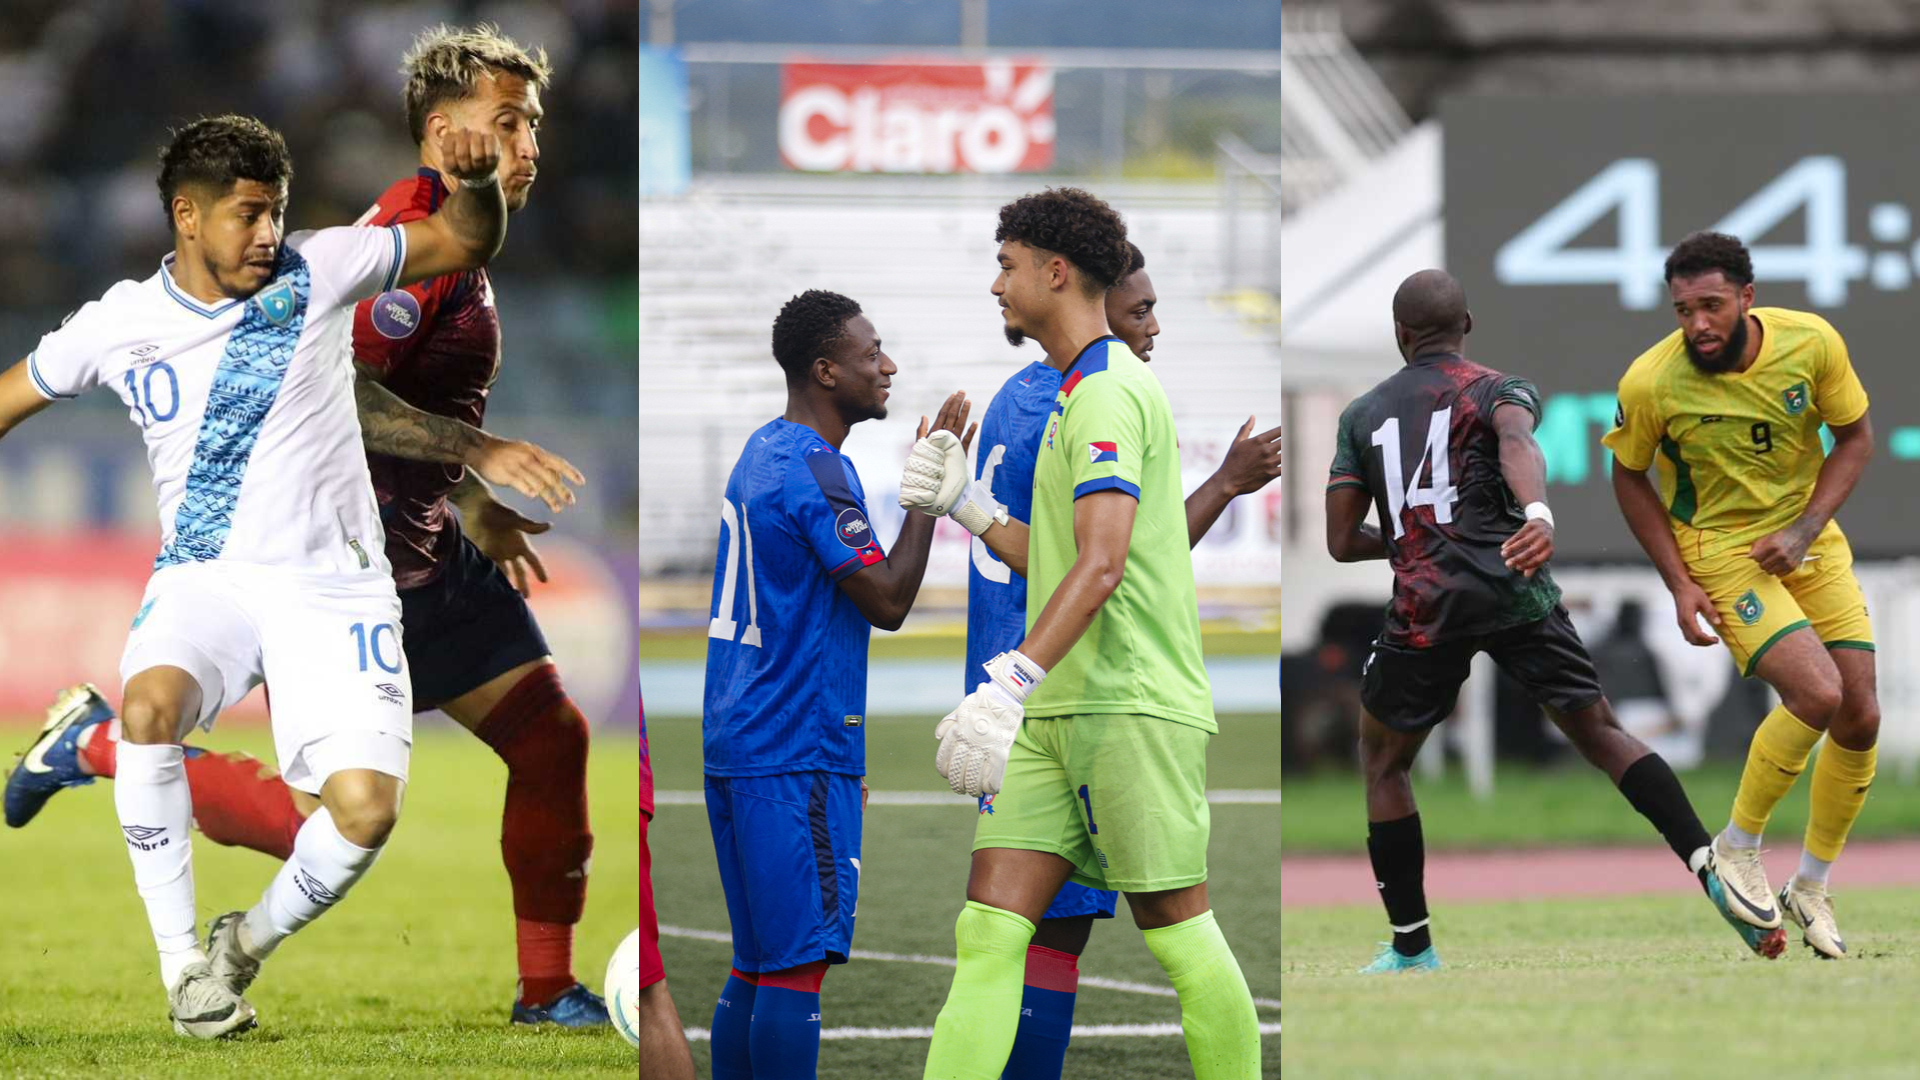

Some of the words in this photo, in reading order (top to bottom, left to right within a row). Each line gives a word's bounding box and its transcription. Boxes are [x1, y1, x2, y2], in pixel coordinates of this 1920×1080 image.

[778, 84, 1027, 174] Claro
[1494, 155, 1920, 311] 44:
[124, 361, 180, 428] 10
[1751, 421, 1772, 455] 9
[1371, 405, 1459, 540] 14
[349, 622, 403, 674] 10
[1078, 784, 1098, 835] 1
